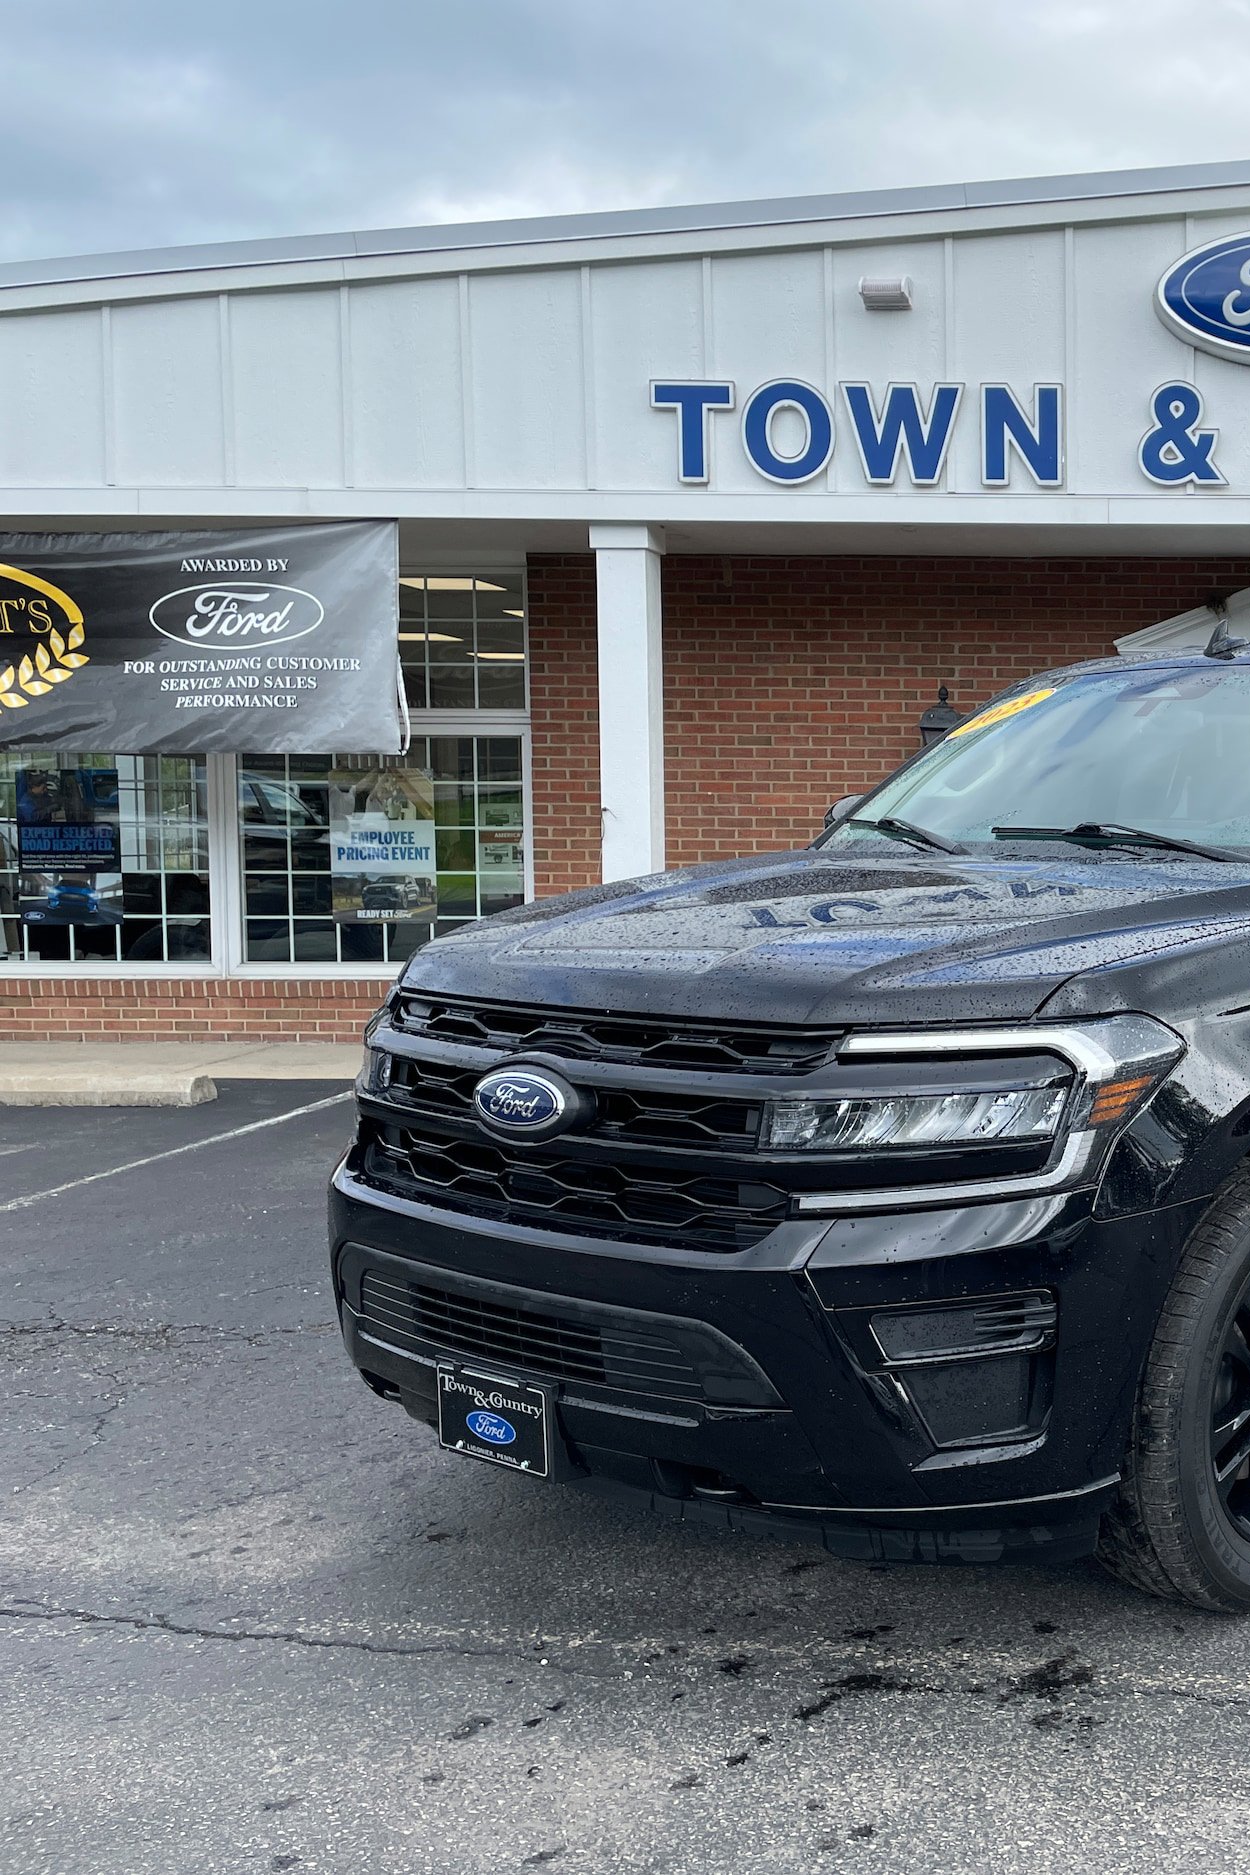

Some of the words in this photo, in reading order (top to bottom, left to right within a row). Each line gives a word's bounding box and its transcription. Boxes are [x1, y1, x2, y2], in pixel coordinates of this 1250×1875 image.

[650, 378, 1064, 487] TOWN
[1137, 380, 1229, 486] &
[180, 559, 263, 573] AWARDED
[267, 558, 289, 572] BY
[186, 591, 295, 637] Ford
[124, 660, 155, 674] FOR
[159, 657, 262, 673] OUTSTANDING
[266, 656, 361, 671] CUSTOMER
[160, 677, 222, 692] SERVICE
[226, 675, 259, 689] AND
[264, 675, 318, 690] SALES
[175, 694, 298, 709] PERFORMANCE
[21, 826, 61, 839] EXPERT
[350, 831, 415, 845] EMPLOYEE
[21, 839, 51, 851] ROAD
[52, 839, 115, 851] RESPECTED.
[337, 846, 389, 860] PRICING
[392, 847, 430, 860] EVENT
[356, 910, 379, 919] READY
[380, 910, 394, 919] SET
[490, 1083, 540, 1118] Ford
[439, 1373, 477, 1397] Town
[474, 1392, 491, 1409] &
[489, 1392, 543, 1419] Country
[475, 1414, 506, 1440] Ford
